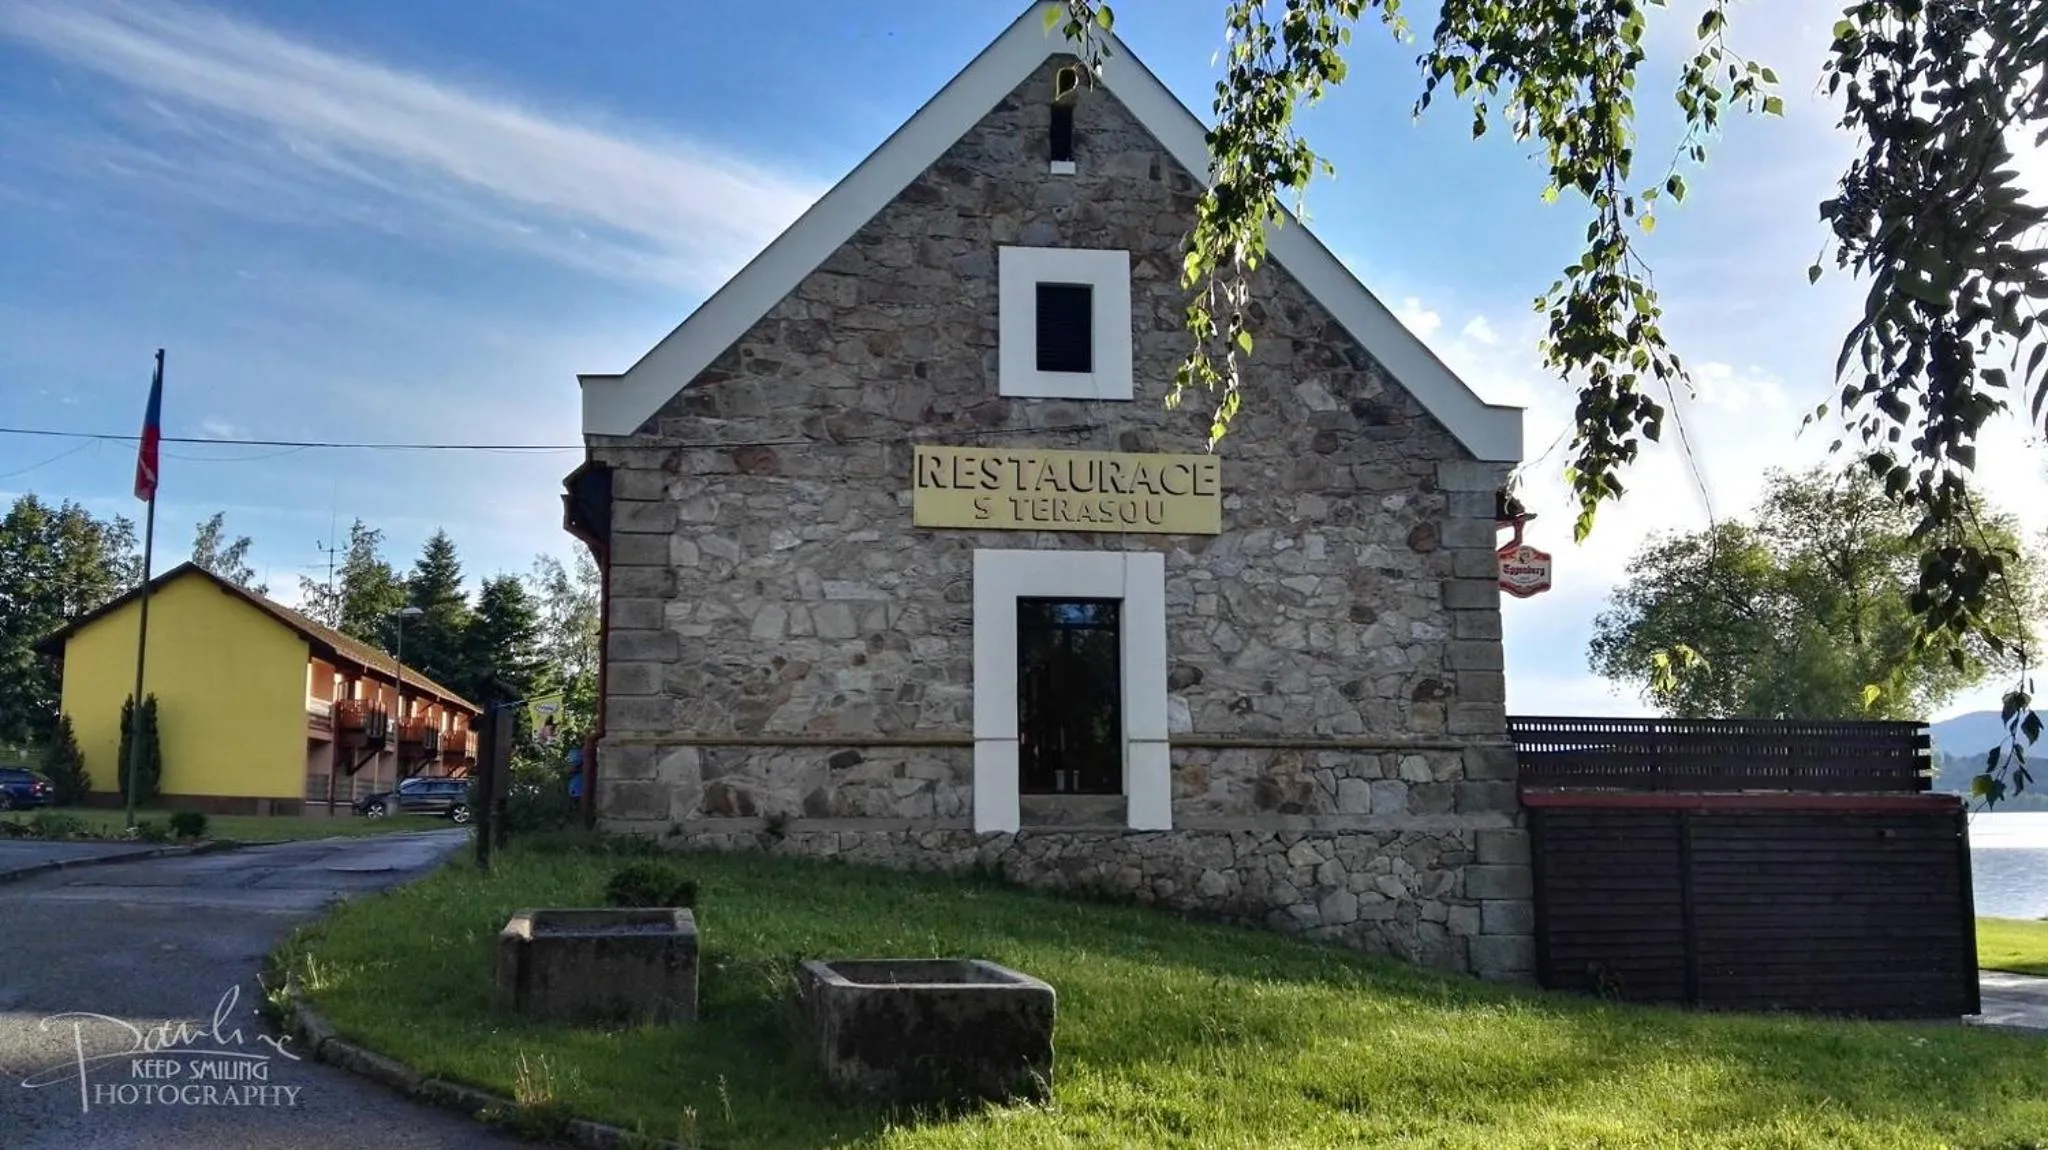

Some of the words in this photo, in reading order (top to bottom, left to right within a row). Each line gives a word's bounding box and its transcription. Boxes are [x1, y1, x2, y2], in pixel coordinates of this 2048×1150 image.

[918, 454, 1215, 496] RESTAURACE
[974, 497, 990, 520] S
[1009, 497, 1165, 525] TERASOU
